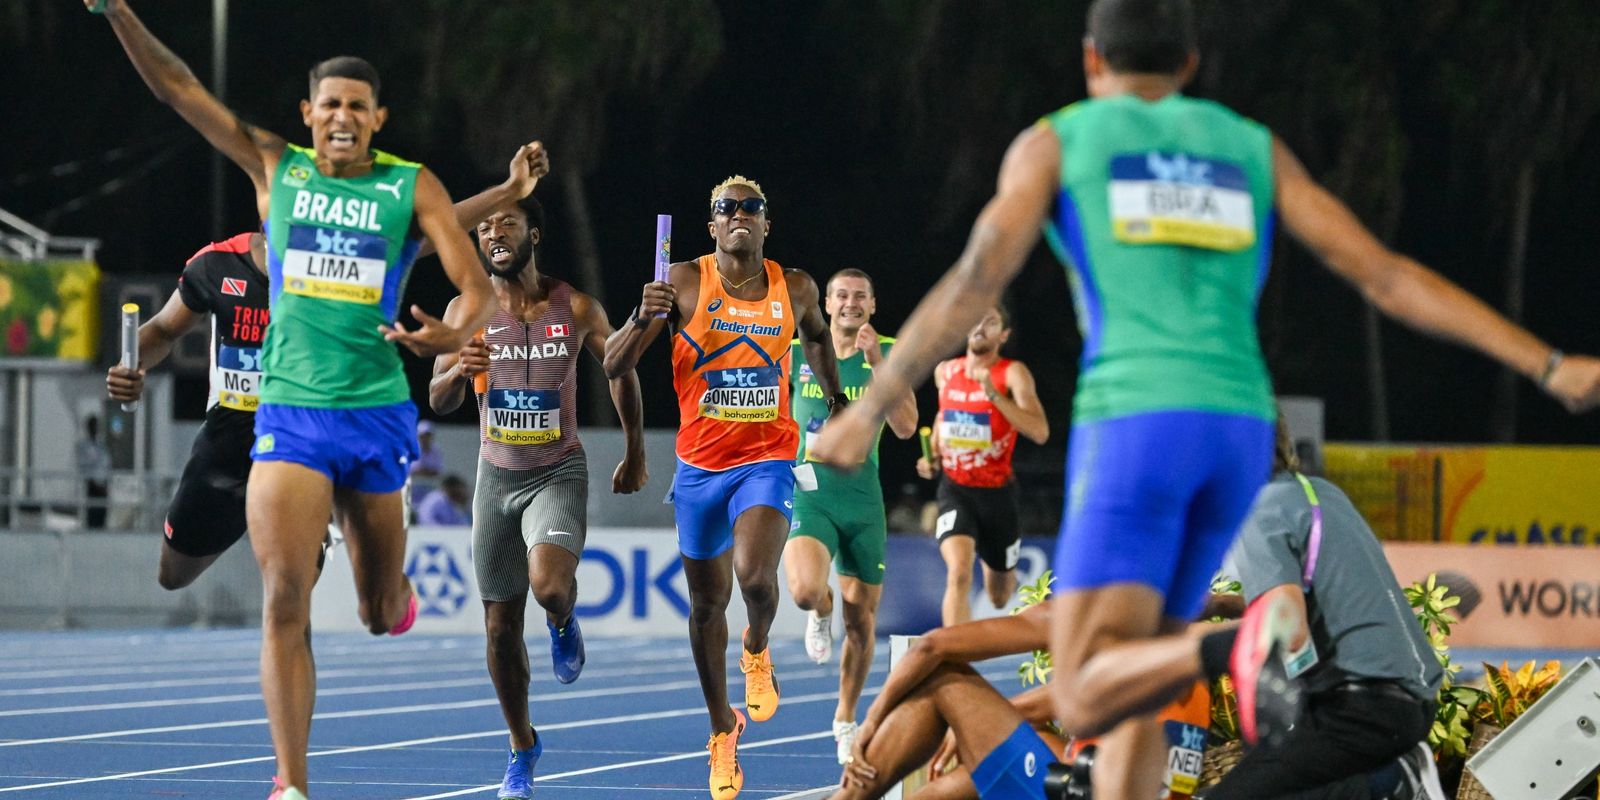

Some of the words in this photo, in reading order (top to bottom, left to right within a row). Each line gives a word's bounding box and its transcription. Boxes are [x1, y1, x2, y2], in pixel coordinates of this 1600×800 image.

[293, 189, 382, 231] BRASIL
[316, 228, 359, 256] btc
[307, 256, 359, 281] LIMA
[710, 318, 781, 336] Nederland
[489, 342, 569, 360] CANADA
[225, 372, 251, 393] Mc
[722, 368, 758, 387] btc
[504, 390, 540, 410] btc
[703, 388, 776, 406] BONEVACIA
[494, 410, 549, 429] WHITE
